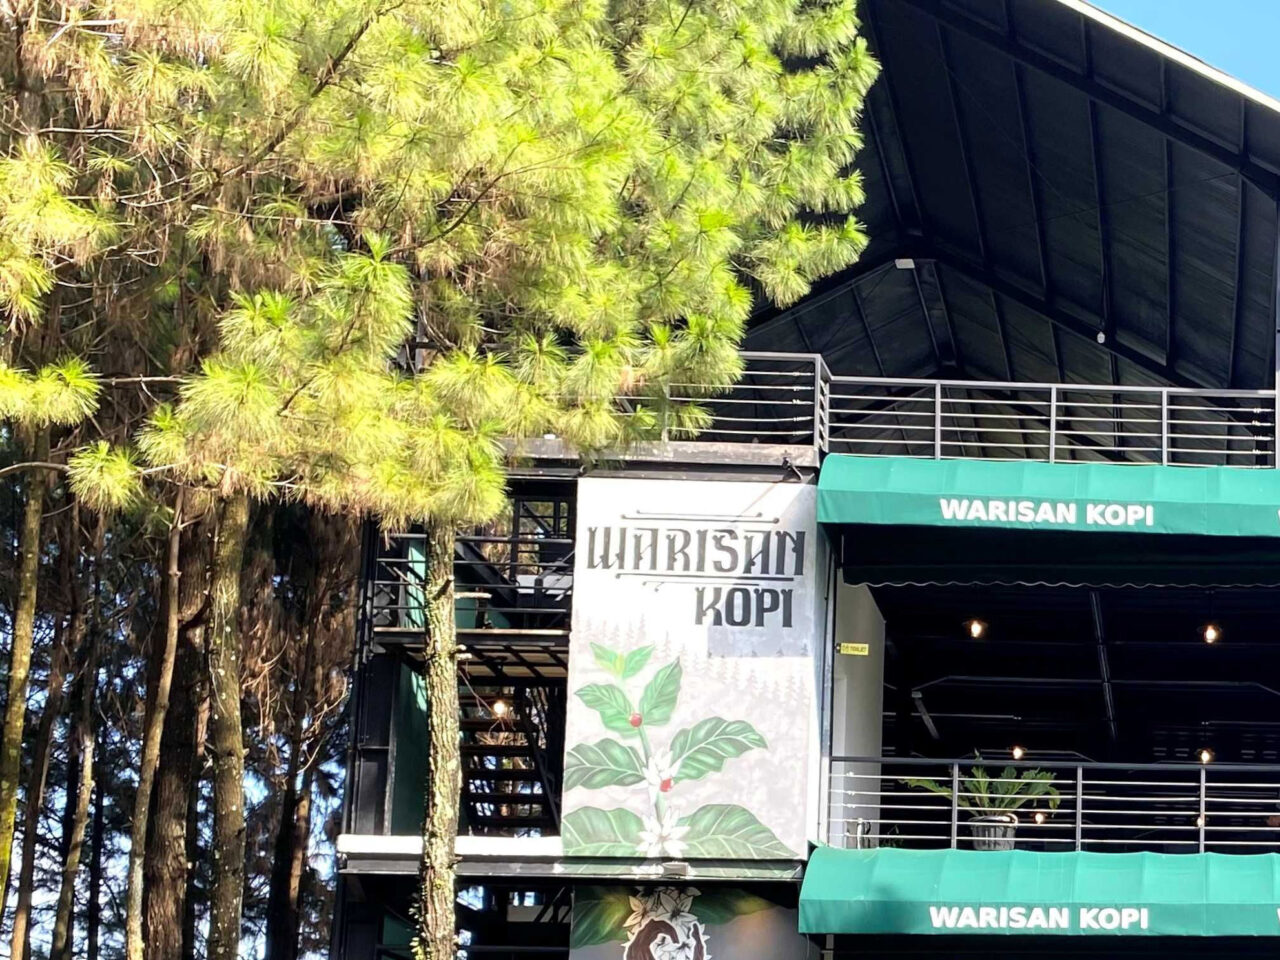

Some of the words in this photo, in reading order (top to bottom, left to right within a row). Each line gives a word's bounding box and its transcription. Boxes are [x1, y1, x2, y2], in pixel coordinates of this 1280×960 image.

[939, 498, 1077, 524] WARISAN
[1086, 504, 1154, 526] KOPI
[586, 526, 806, 576] WARISAN
[694, 586, 794, 628] KOPI
[929, 906, 1069, 929] WARISAN
[1079, 907, 1149, 929] KOPI
